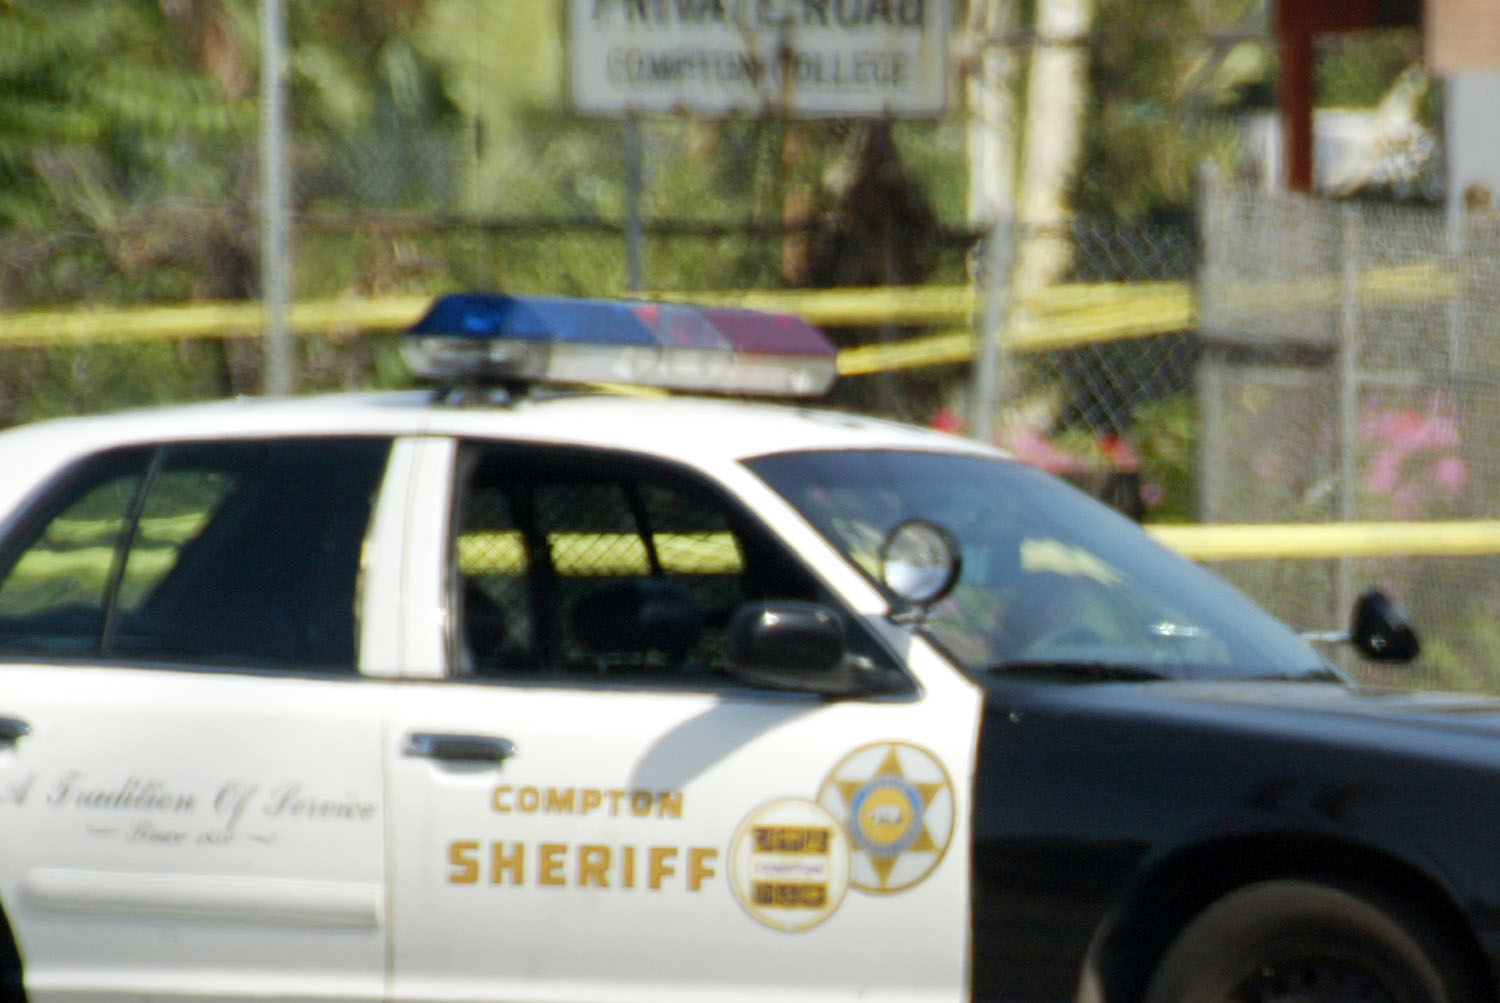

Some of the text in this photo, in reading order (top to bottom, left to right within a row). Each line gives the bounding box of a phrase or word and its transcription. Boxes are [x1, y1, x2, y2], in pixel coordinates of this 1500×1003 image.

[46, 770, 198, 814] Tradition
[264, 782, 378, 822] Service
[490, 784, 684, 819] COMPTON
[447, 840, 719, 892] SHERIFF
